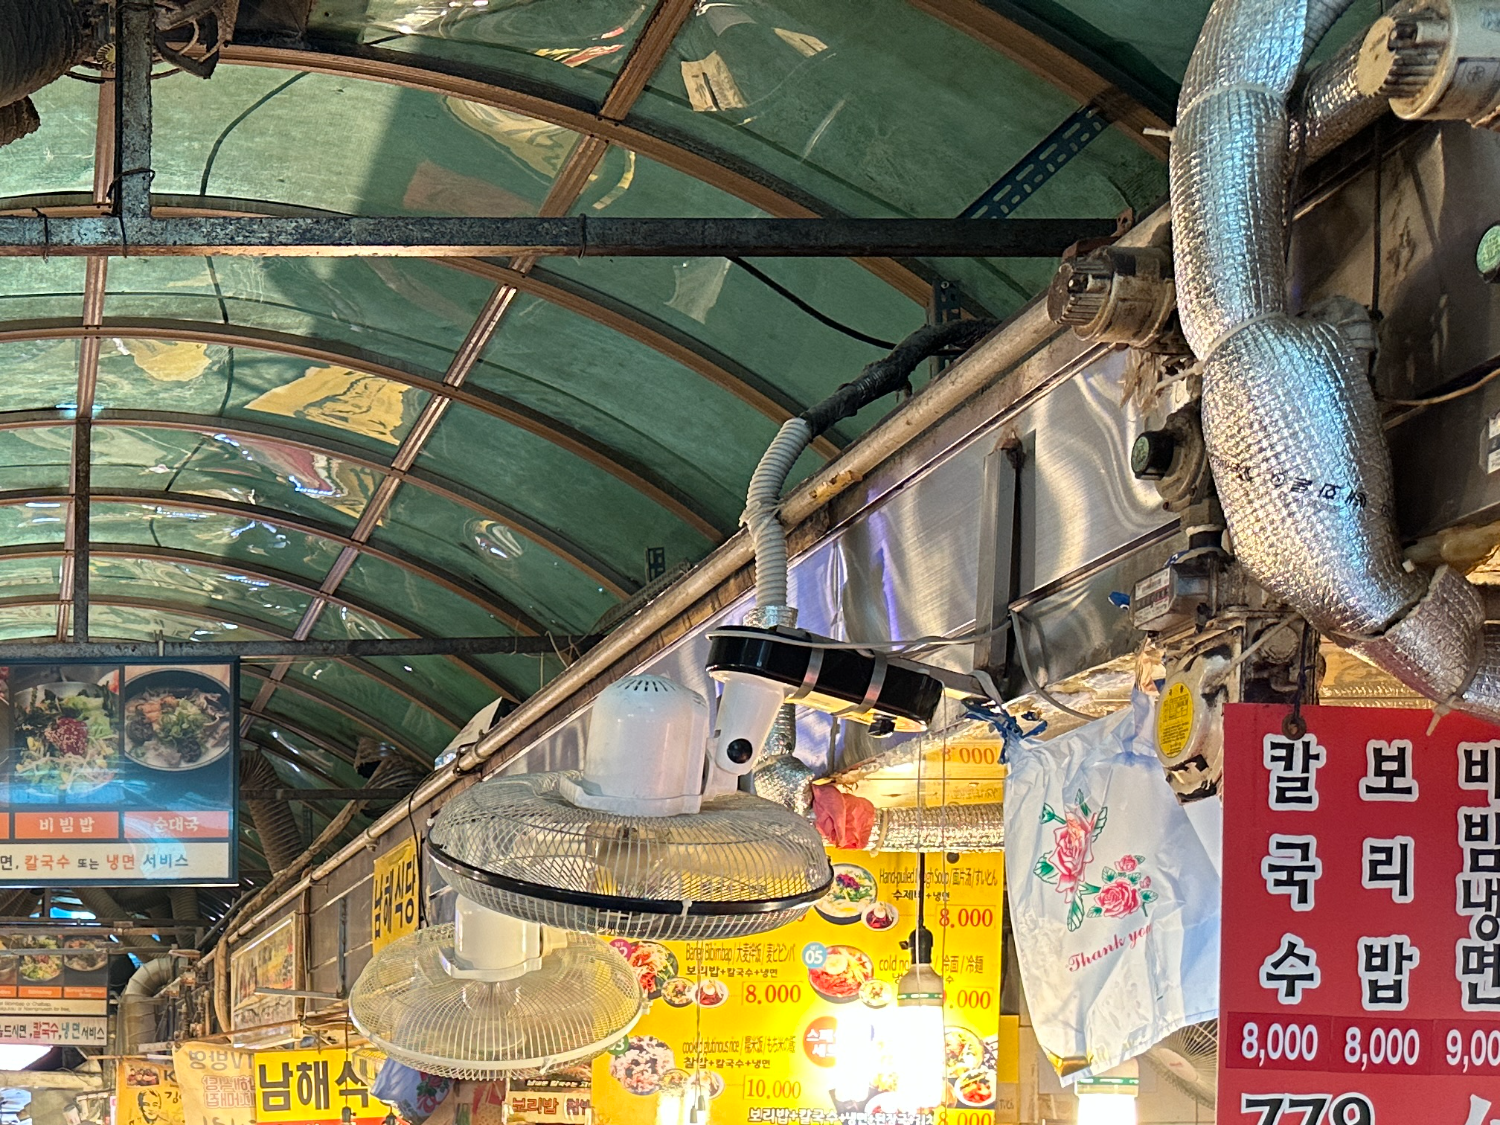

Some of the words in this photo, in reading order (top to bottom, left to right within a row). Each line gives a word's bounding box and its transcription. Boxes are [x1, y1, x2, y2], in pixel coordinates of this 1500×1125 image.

[39, 817, 95, 834] 비빔밥
[153, 816, 199, 833] 순대국
[24, 853, 71, 871] 칼국수
[77, 856, 99, 871] 또는
[106, 853, 135, 871] 냉면
[142, 853, 188, 870] 서비스
[1263, 736, 1323, 1001] 칼국수
[1358, 742, 1415, 1007] 보리밥
[939, 908, 993, 928] 8.000
[805, 949, 823, 965] 05
[1066, 933, 1126, 973] Thank
[1128, 921, 1154, 948] you
[879, 954, 897, 972] cold
[745, 984, 801, 1005] 8.000
[943, 989, 992, 1010] .000
[81, 1025, 105, 1041] 서비스
[1241, 1022, 1319, 1066] 8,000
[1344, 1026, 1420, 1072] 8,000
[746, 1079, 801, 1100] 10.000
[512, 1097, 559, 1115] 보리밥
